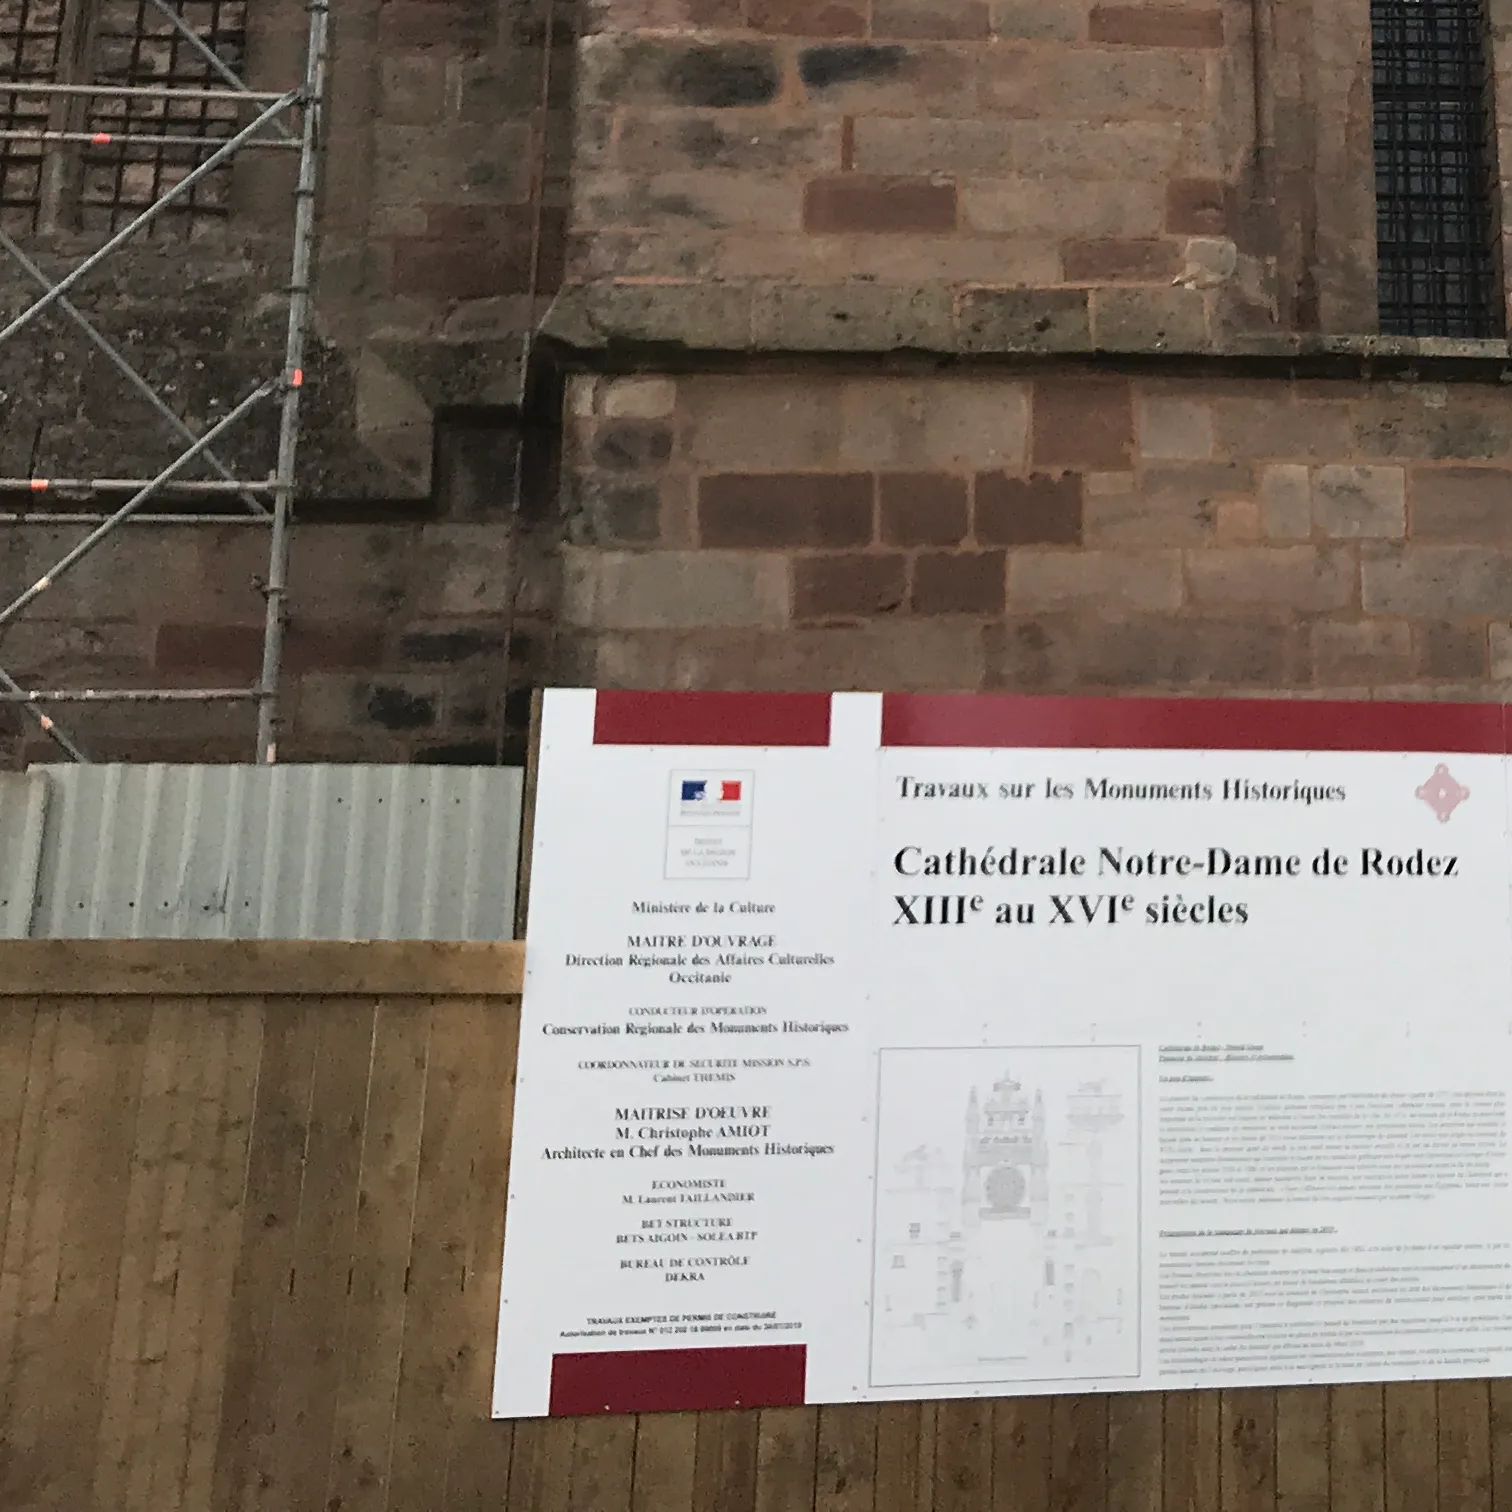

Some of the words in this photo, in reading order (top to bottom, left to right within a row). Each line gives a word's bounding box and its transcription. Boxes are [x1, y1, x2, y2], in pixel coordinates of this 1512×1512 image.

[897, 777, 988, 798] Travaux
[999, 784, 1035, 799] sur
[1046, 778, 1073, 799] les
[1086, 778, 1212, 800] Monuments
[1223, 779, 1345, 805] Historiques
[894, 847, 1085, 875] Cathédrale
[1099, 848, 1300, 875] Notre-Dame
[1312, 848, 1347, 875] de
[1362, 849, 1458, 876] Rodez
[633, 902, 691, 913] Ministère
[696, 902, 709, 913] de
[713, 902, 724, 914] la
[729, 902, 775, 913] Culture
[996, 904, 1034, 924] au
[1146, 895, 1248, 923] siècles
[692, 935, 774, 947] D'OUVRAGE
[566, 954, 623, 966] Direction
[692, 954, 710, 966] des
[715, 954, 764, 965] Affaires
[768, 953, 835, 965] Culturelles
[669, 972, 731, 983] Occitanie
[629, 1007, 698, 1016] CONDUCTEUR
[543, 1023, 620, 1035] Conservation
[687, 1022, 705, 1033] des
[711, 1022, 778, 1033] Monuments
[783, 1021, 849, 1035] Historiques
[578, 1060, 670, 1069] COORDONNATEUR
[673, 1060, 684, 1068] DE
[743, 1058, 784, 1068] MISSION
[653, 1074, 690, 1082] Cabinet
[694, 1073, 735, 1082] THEMIS
[696, 1106, 768, 1119] D'OEUVRE
[616, 1127, 633, 1139] M.
[638, 1127, 713, 1141] Christophe
[717, 1125, 769, 1137] AMIOT
[543, 1147, 605, 1159] Architecte
[610, 1149, 624, 1158] en
[629, 1145, 660, 1158] Chef
[664, 1145, 682, 1158] des
[689, 1144, 759, 1156] Monuments
[765, 1143, 834, 1157] Historiques
[623, 1195, 633, 1204] M.
[638, 1195, 676, 1204] Laurent
[680, 1193, 754, 1202] TAILLANDIER
[642, 1219, 662, 1229] BET
[666, 1218, 732, 1228] STRUCTURE
[616, 1235, 644, 1243] BETS
[736, 1231, 758, 1240] BTP
[620, 1259, 664, 1269] BUREAU
[670, 1259, 684, 1267] DE
[688, 1255, 748, 1266] CONTRÔLE
[666, 1272, 705, 1282] DEKRA
[587, 1317, 623, 1325] TRAVAUX
[669, 1315, 680, 1323] DE
[726, 1311, 776, 1320] CONSTRUIRE
